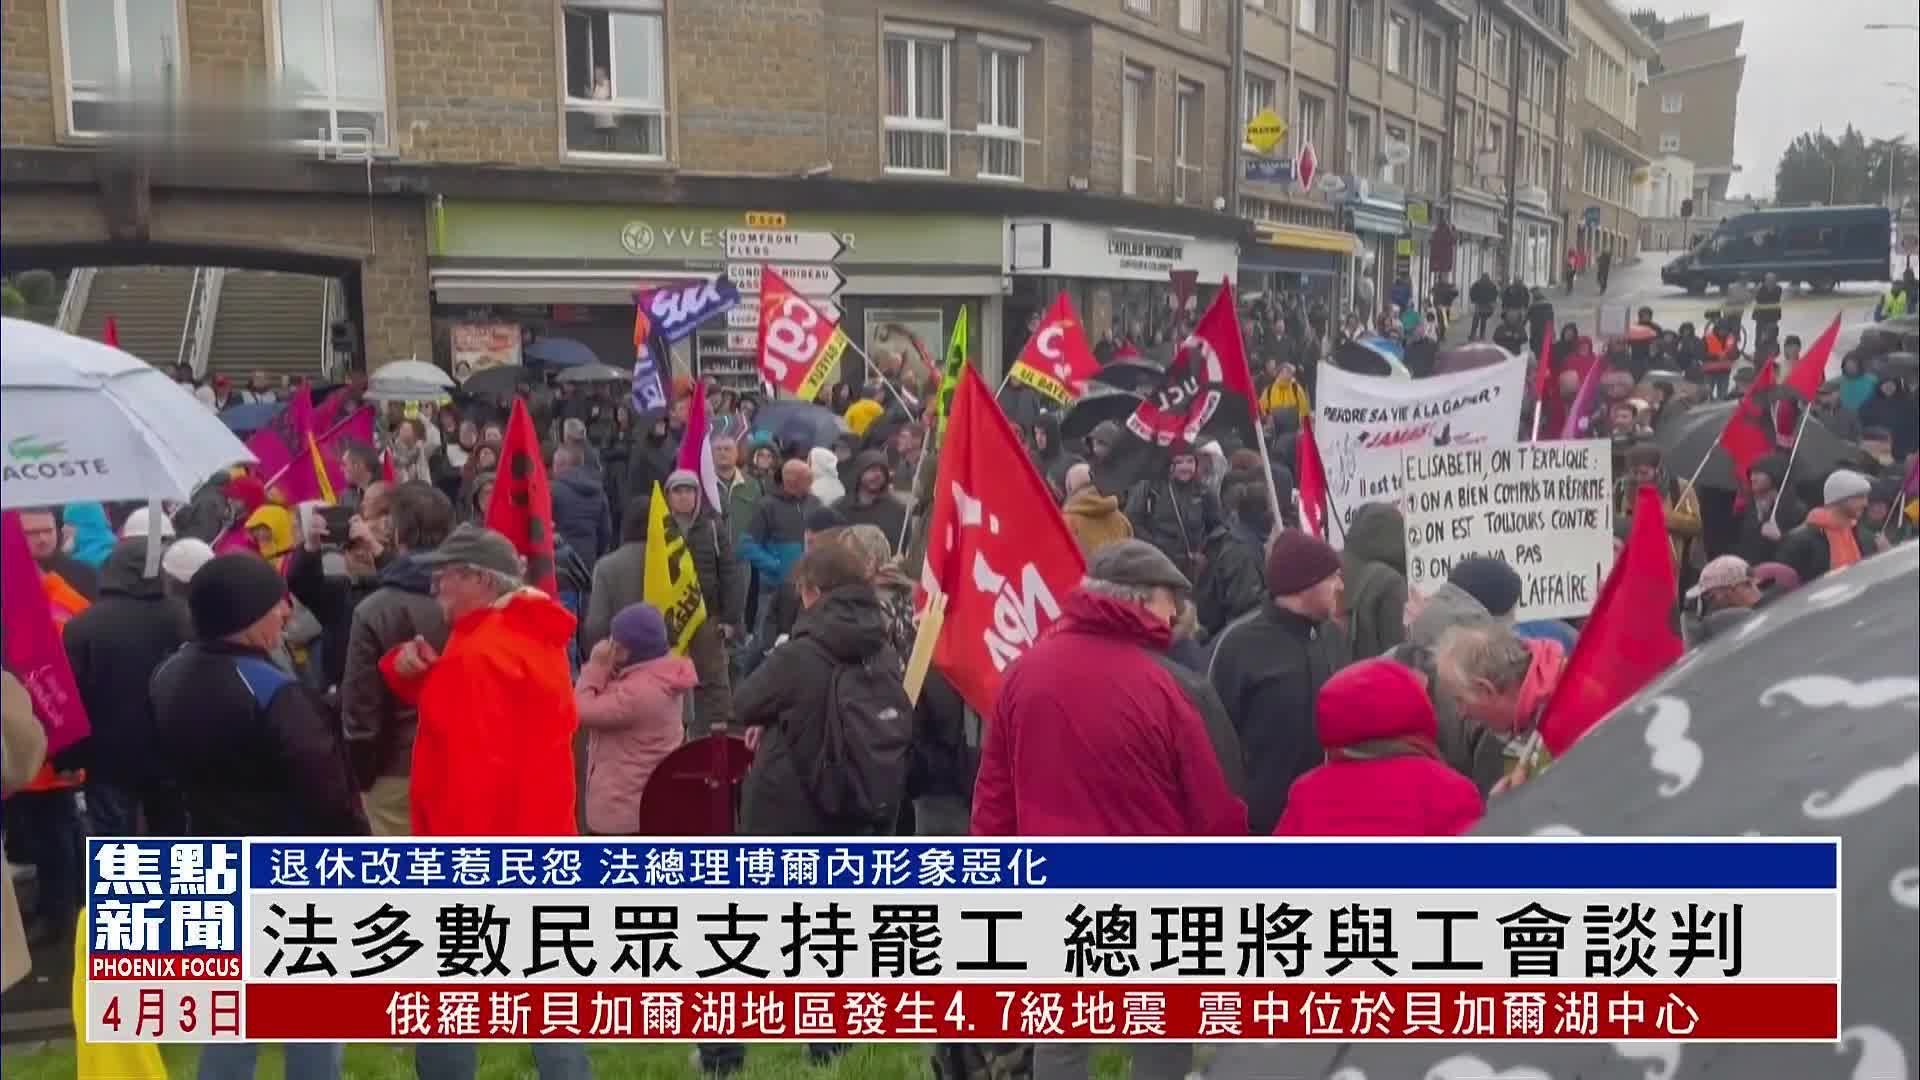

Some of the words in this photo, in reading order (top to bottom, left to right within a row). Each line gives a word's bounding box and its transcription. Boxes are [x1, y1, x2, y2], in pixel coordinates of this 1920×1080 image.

[663, 228, 726, 248] YVES
[730, 233, 799, 244] DOMFRONT
[1368, 407, 1388, 422] SA
[1391, 405, 1408, 421] VIE
[1424, 402, 1440, 418] LA
[4, 457, 109, 481] ACOSTE
[1407, 450, 1488, 480] ELISABETH,
[1491, 449, 1511, 472] ON
[1421, 493, 1439, 513] ON
[1444, 492, 1453, 511] A
[1458, 483, 1488, 507] BIEN
[1494, 476, 1541, 505] COMPRIS
[1543, 479, 1555, 500] TA
[1426, 521, 1444, 543] ON
[1452, 515, 1474, 540] EST
[1484, 510, 1545, 534] TOUJOURS
[1551, 508, 1598, 530] CONTRE
[1430, 556, 1451, 579] ON
[1516, 544, 1542, 565] PAS
[1519, 572, 1588, 608] L'AFFAIRE
